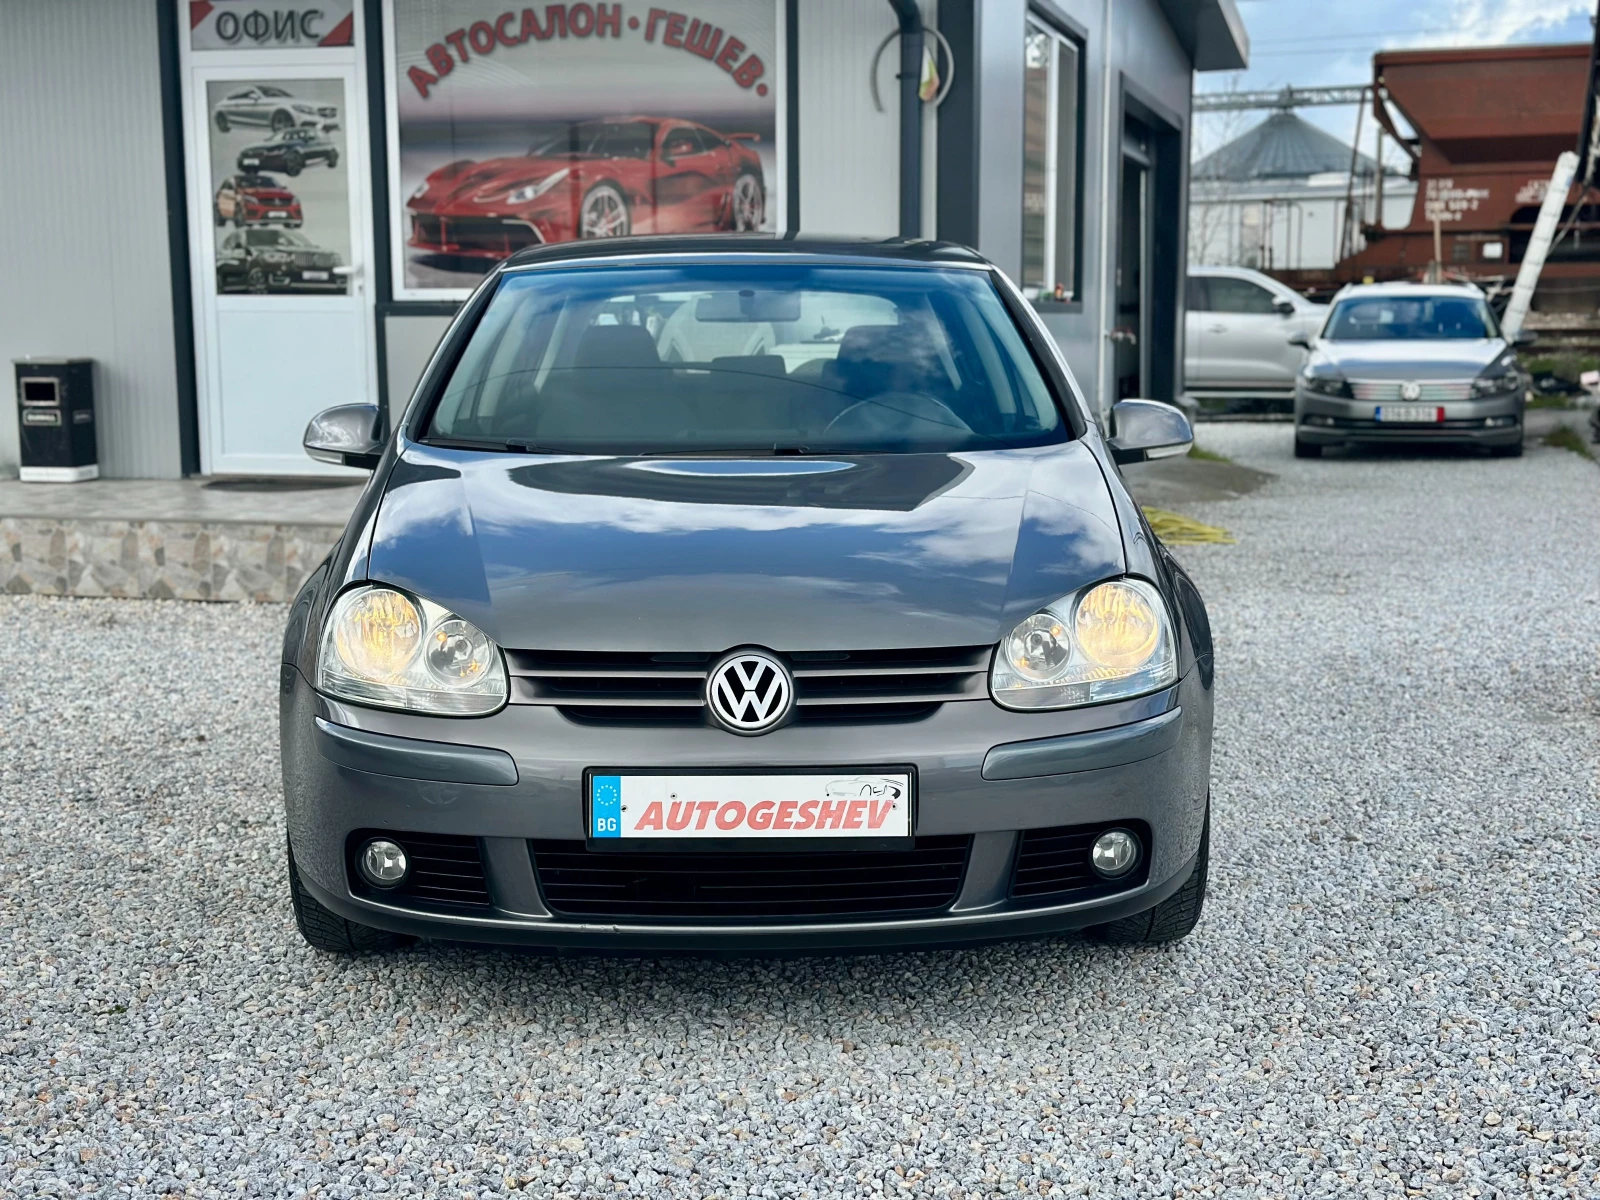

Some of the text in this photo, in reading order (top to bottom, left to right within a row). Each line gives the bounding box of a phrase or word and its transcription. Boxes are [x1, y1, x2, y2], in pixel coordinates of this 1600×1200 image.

[215, 9, 322, 43] ОФИС
[406, 2, 622, 100] АВТОСАЛОН
[597, 817, 617, 832] BG
[633, 800, 895, 831] AUTOGESHEV
